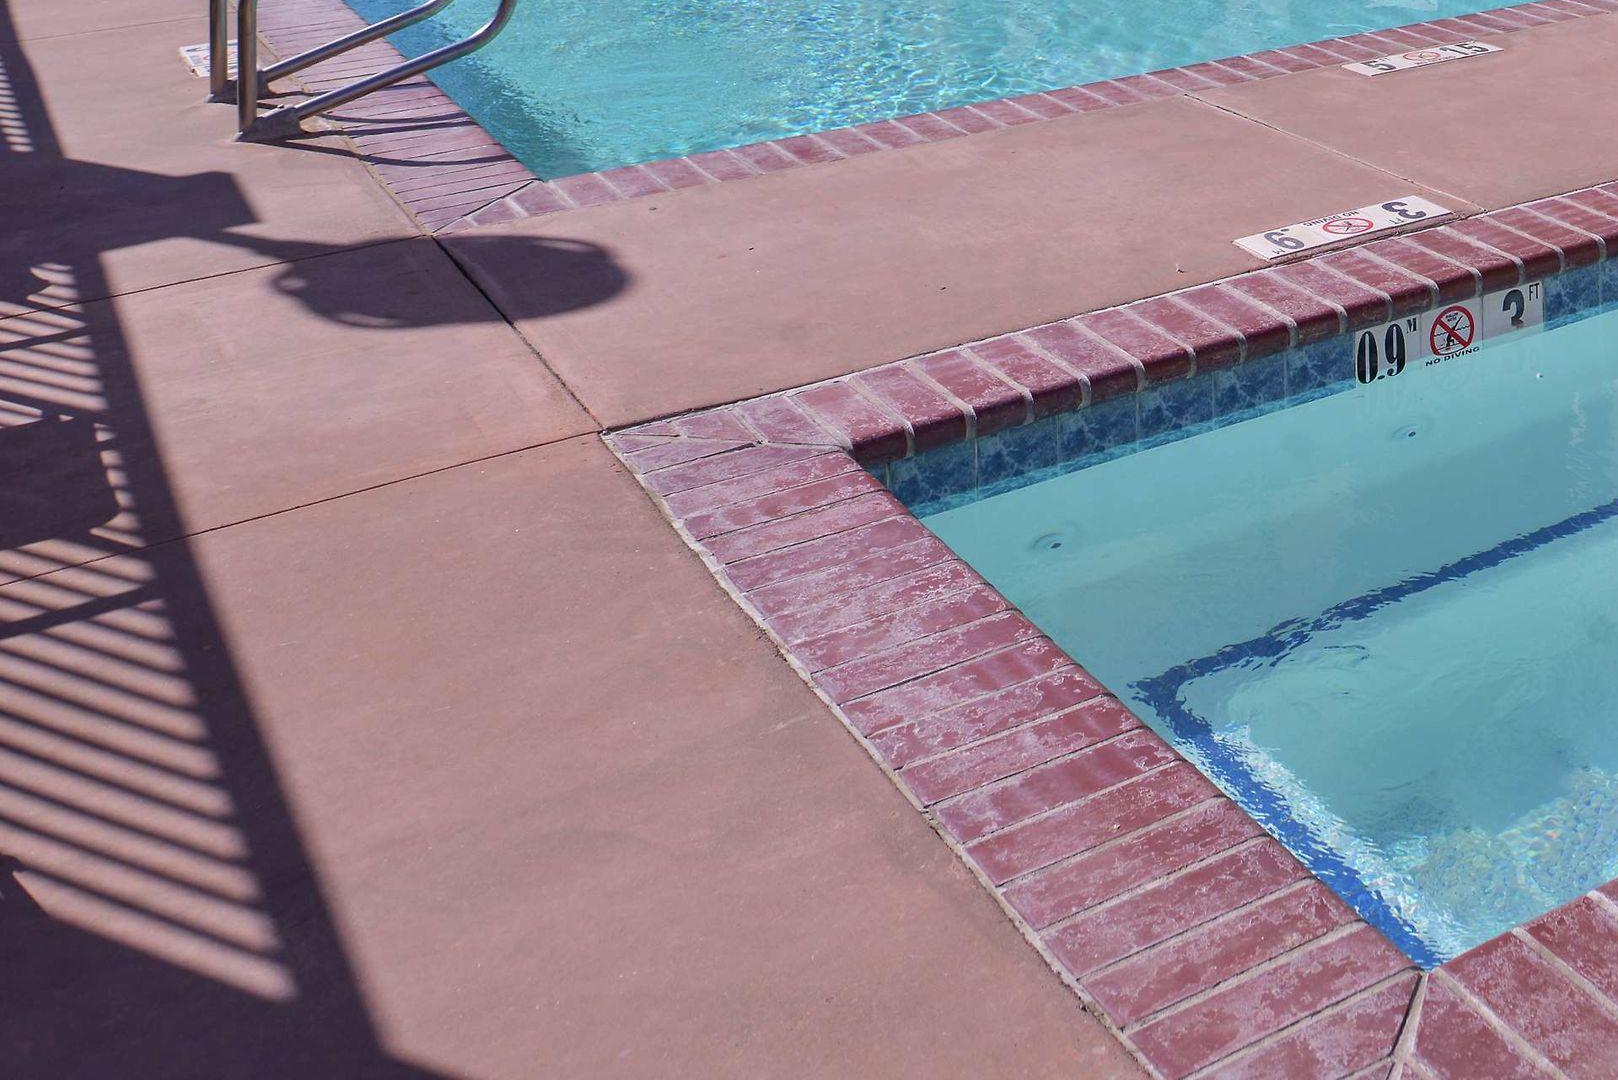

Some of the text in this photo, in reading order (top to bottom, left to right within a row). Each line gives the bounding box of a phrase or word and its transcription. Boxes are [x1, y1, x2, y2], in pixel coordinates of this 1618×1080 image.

[1381, 201, 1427, 219] 3
[1528, 282, 1540, 301] FT
[1425, 345, 1480, 367] NO DIVING
